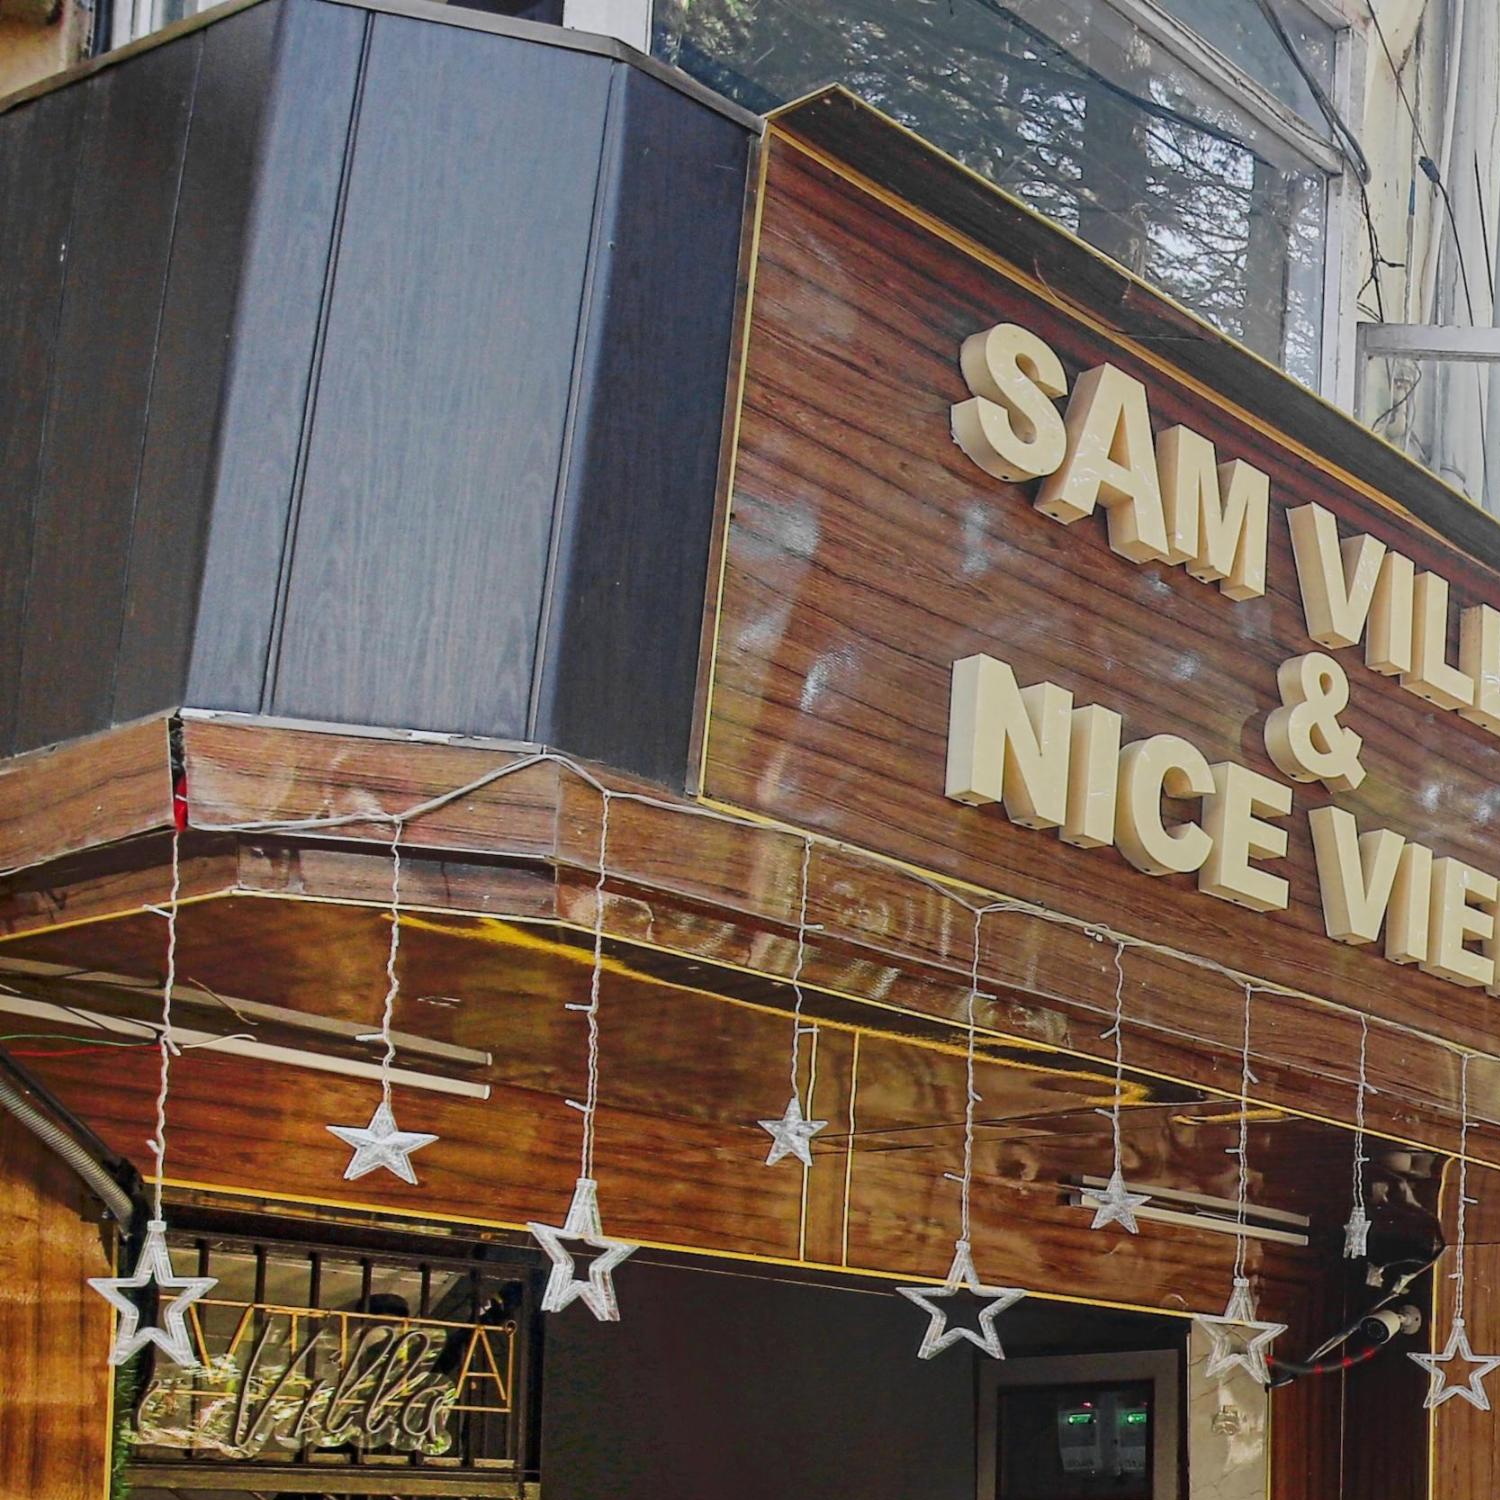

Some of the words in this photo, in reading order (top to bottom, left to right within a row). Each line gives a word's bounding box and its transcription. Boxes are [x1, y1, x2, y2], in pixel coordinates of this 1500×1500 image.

[951, 322, 1270, 602] SAM
[945, 653, 1293, 912] NICE
[1264, 652, 1367, 793] &
